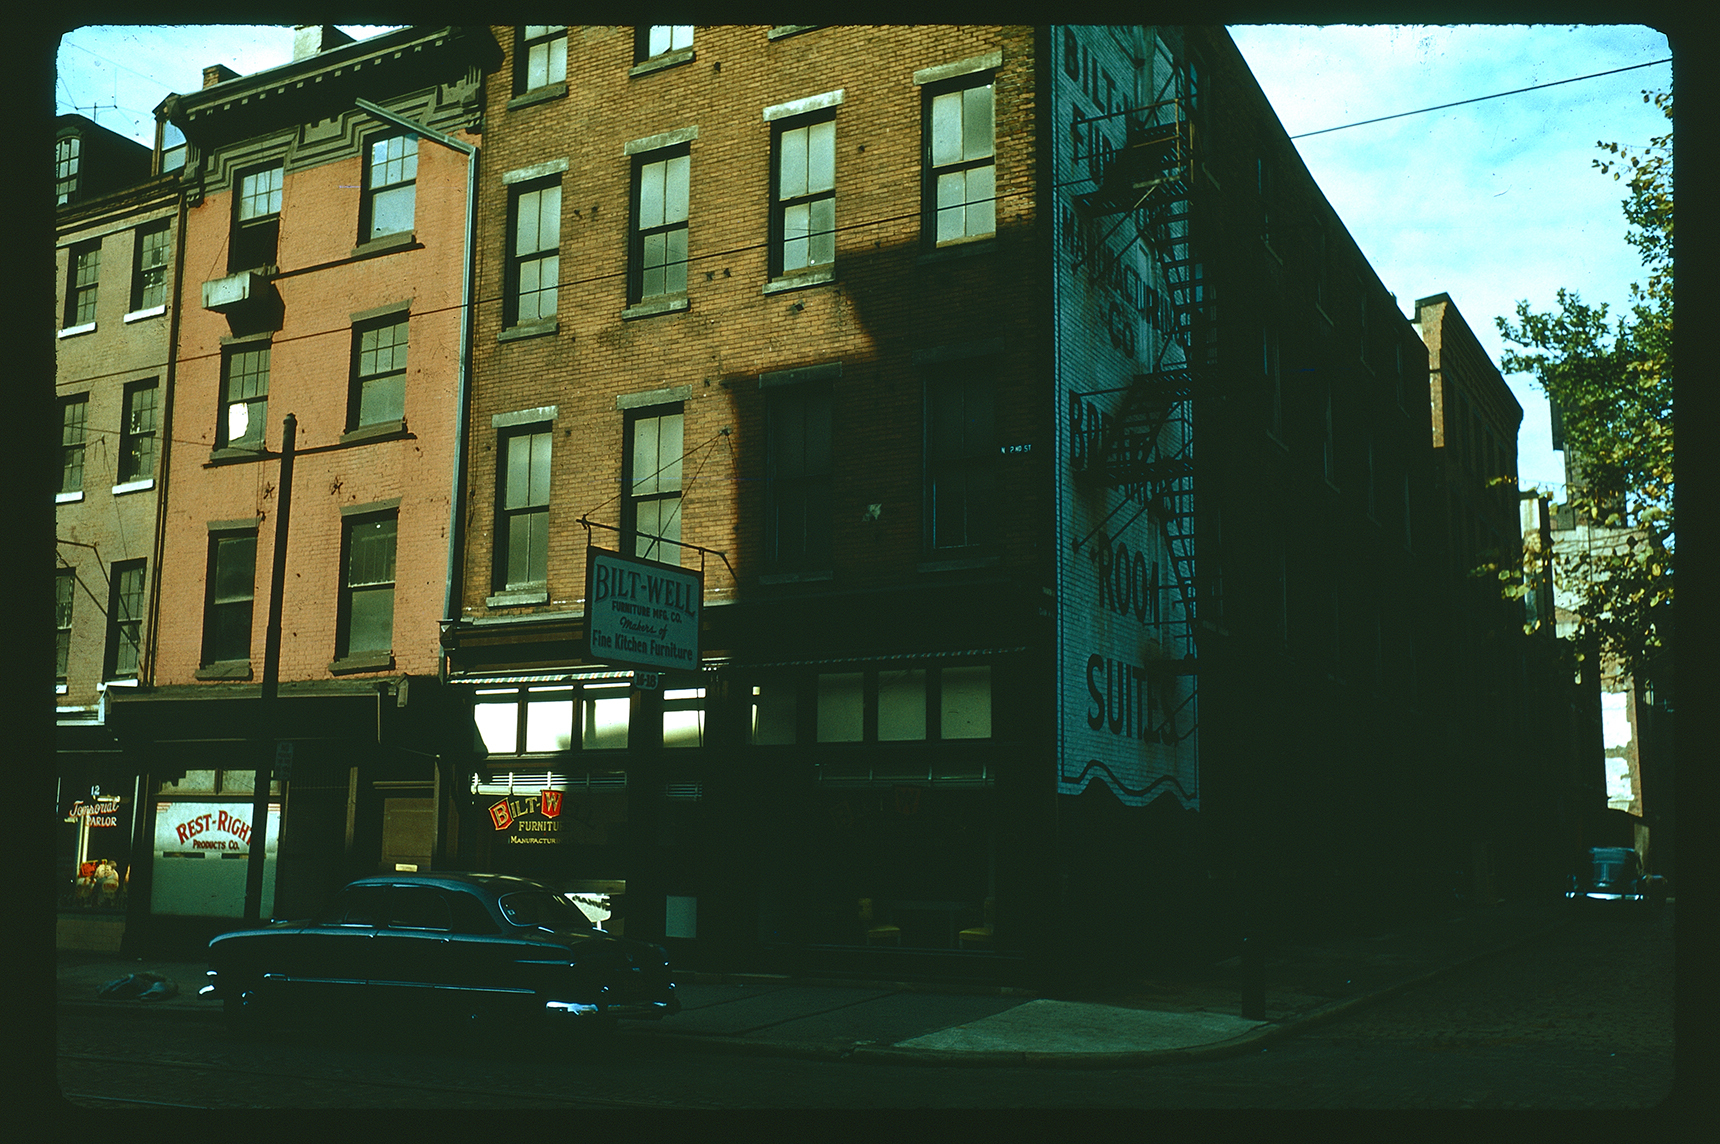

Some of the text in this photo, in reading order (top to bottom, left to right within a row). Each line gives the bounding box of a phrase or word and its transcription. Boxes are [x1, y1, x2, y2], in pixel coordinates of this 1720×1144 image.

[594, 563, 696, 618] BILT-WELL
[612, 600, 683, 624] FURNITURE MFG. CO.
[620, 616, 668, 641] Makers of
[593, 629, 693, 661] Fine Kitchen Furniture
[90, 785, 101, 796] 12
[86, 815, 118, 828] PARLOR
[176, 810, 253, 845] REST-RIGH
[518, 820, 562, 832] FURNITU
